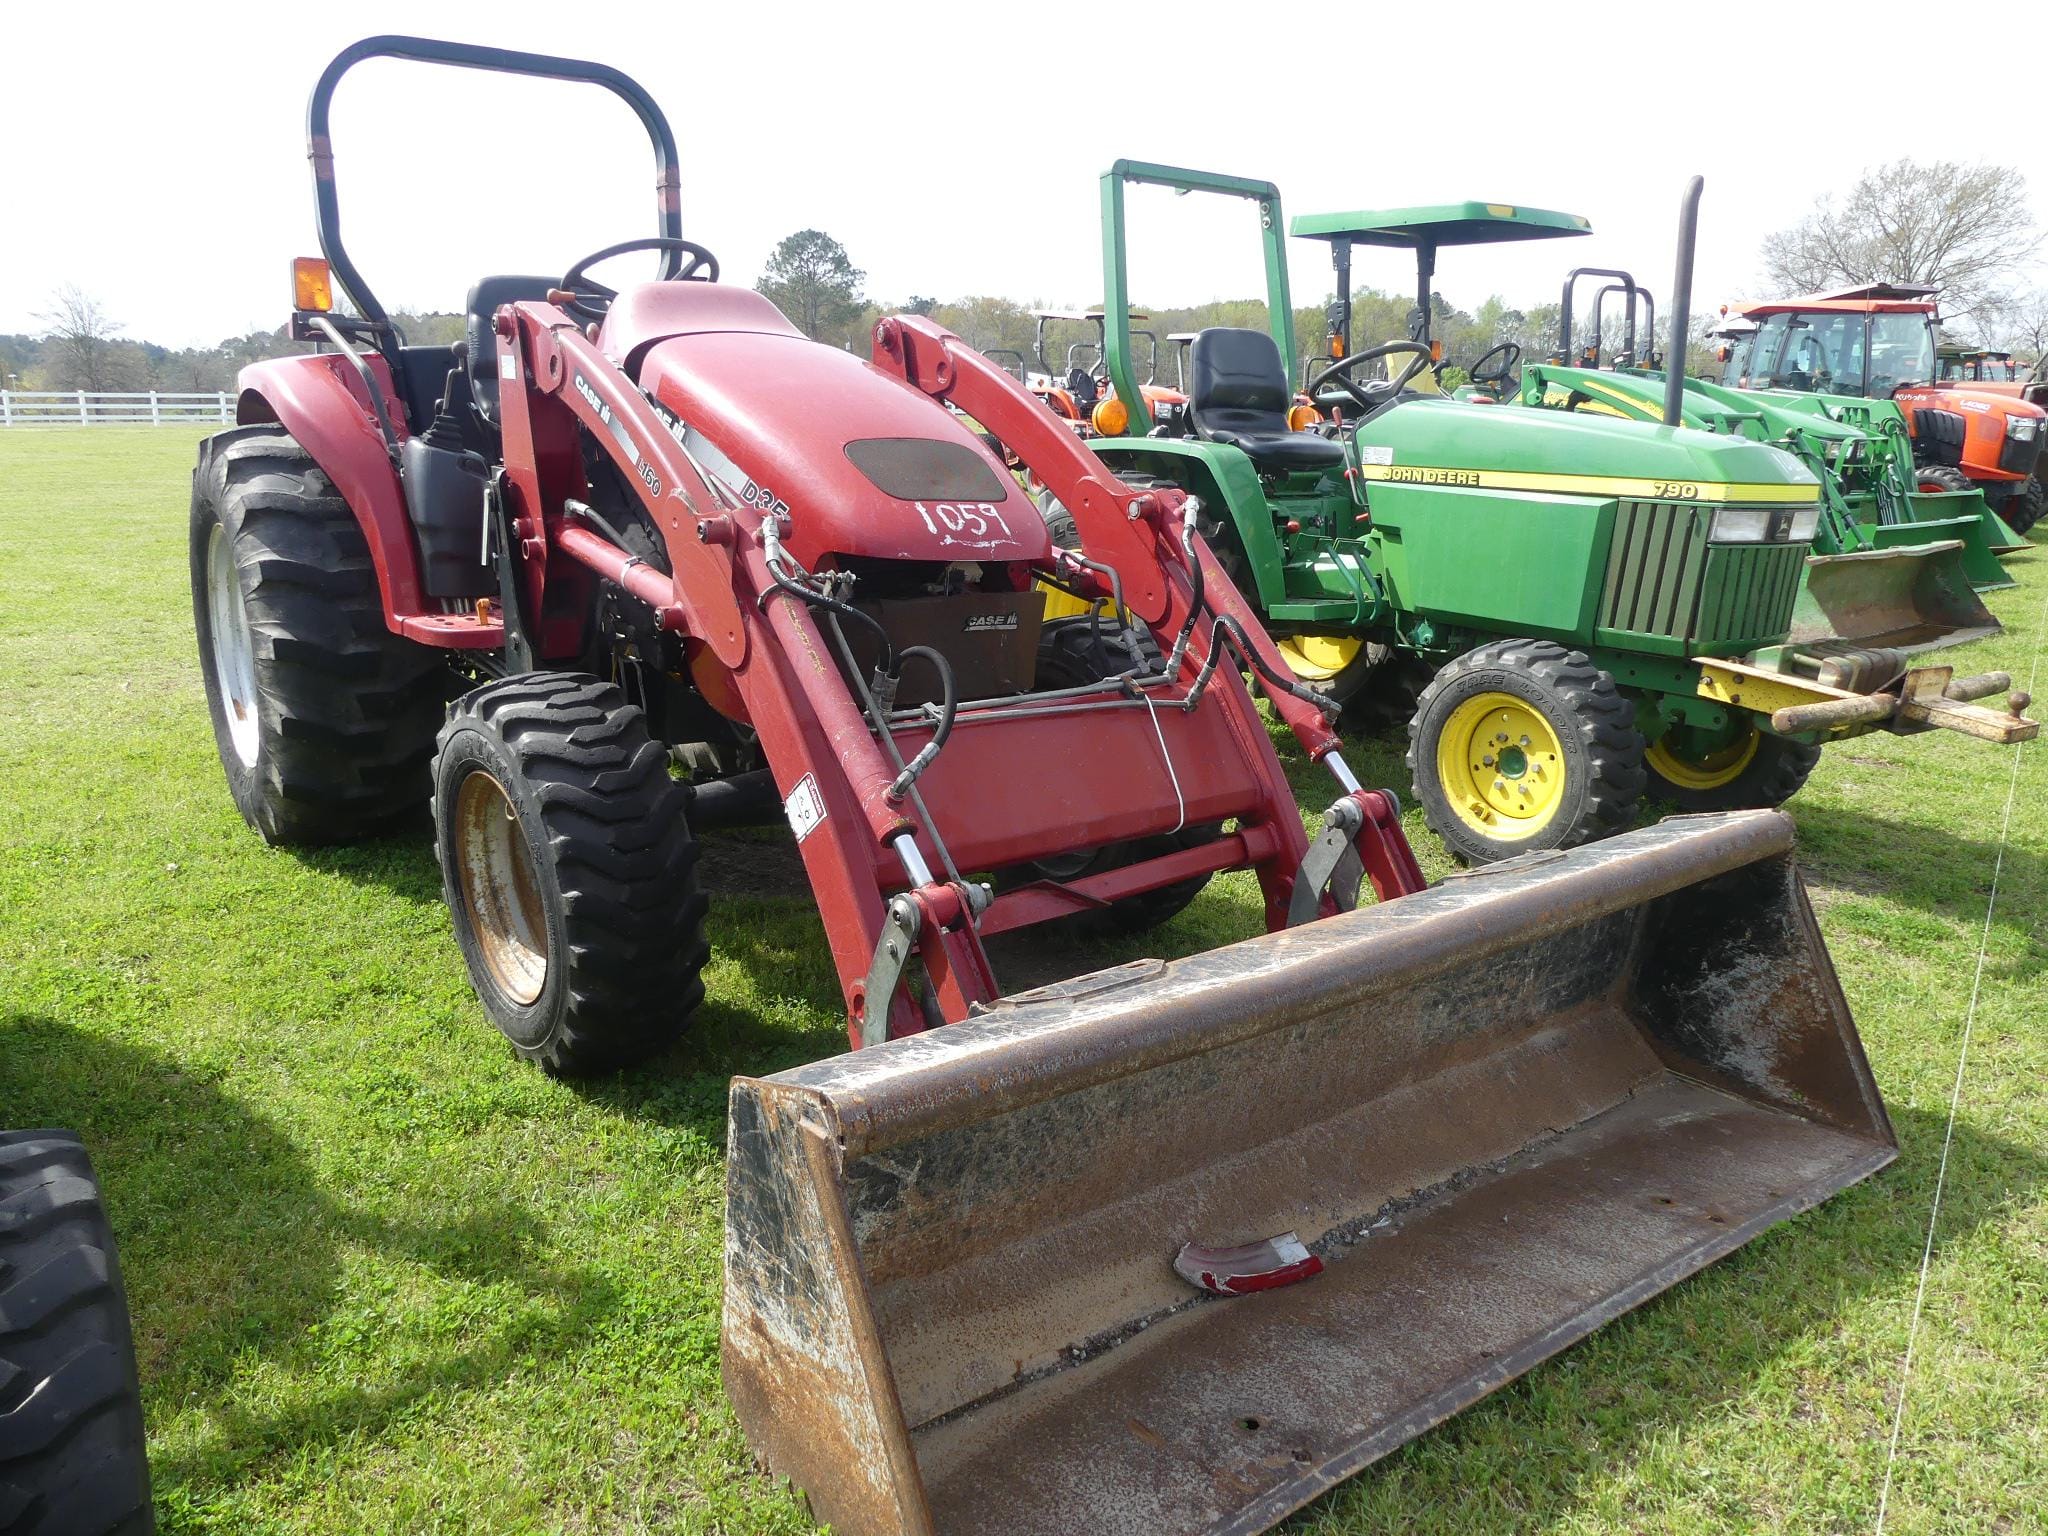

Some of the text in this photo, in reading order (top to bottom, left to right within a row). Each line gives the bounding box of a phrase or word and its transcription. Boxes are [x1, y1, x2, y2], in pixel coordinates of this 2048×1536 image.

[576, 375, 601, 413] CASE
[1383, 467, 1480, 487] JOHN DEERE
[1653, 481, 1699, 499] 790
[914, 501, 1012, 538] 1059
[969, 615, 1005, 626] CASE
[1457, 674, 1578, 754] TRAC LOADER
